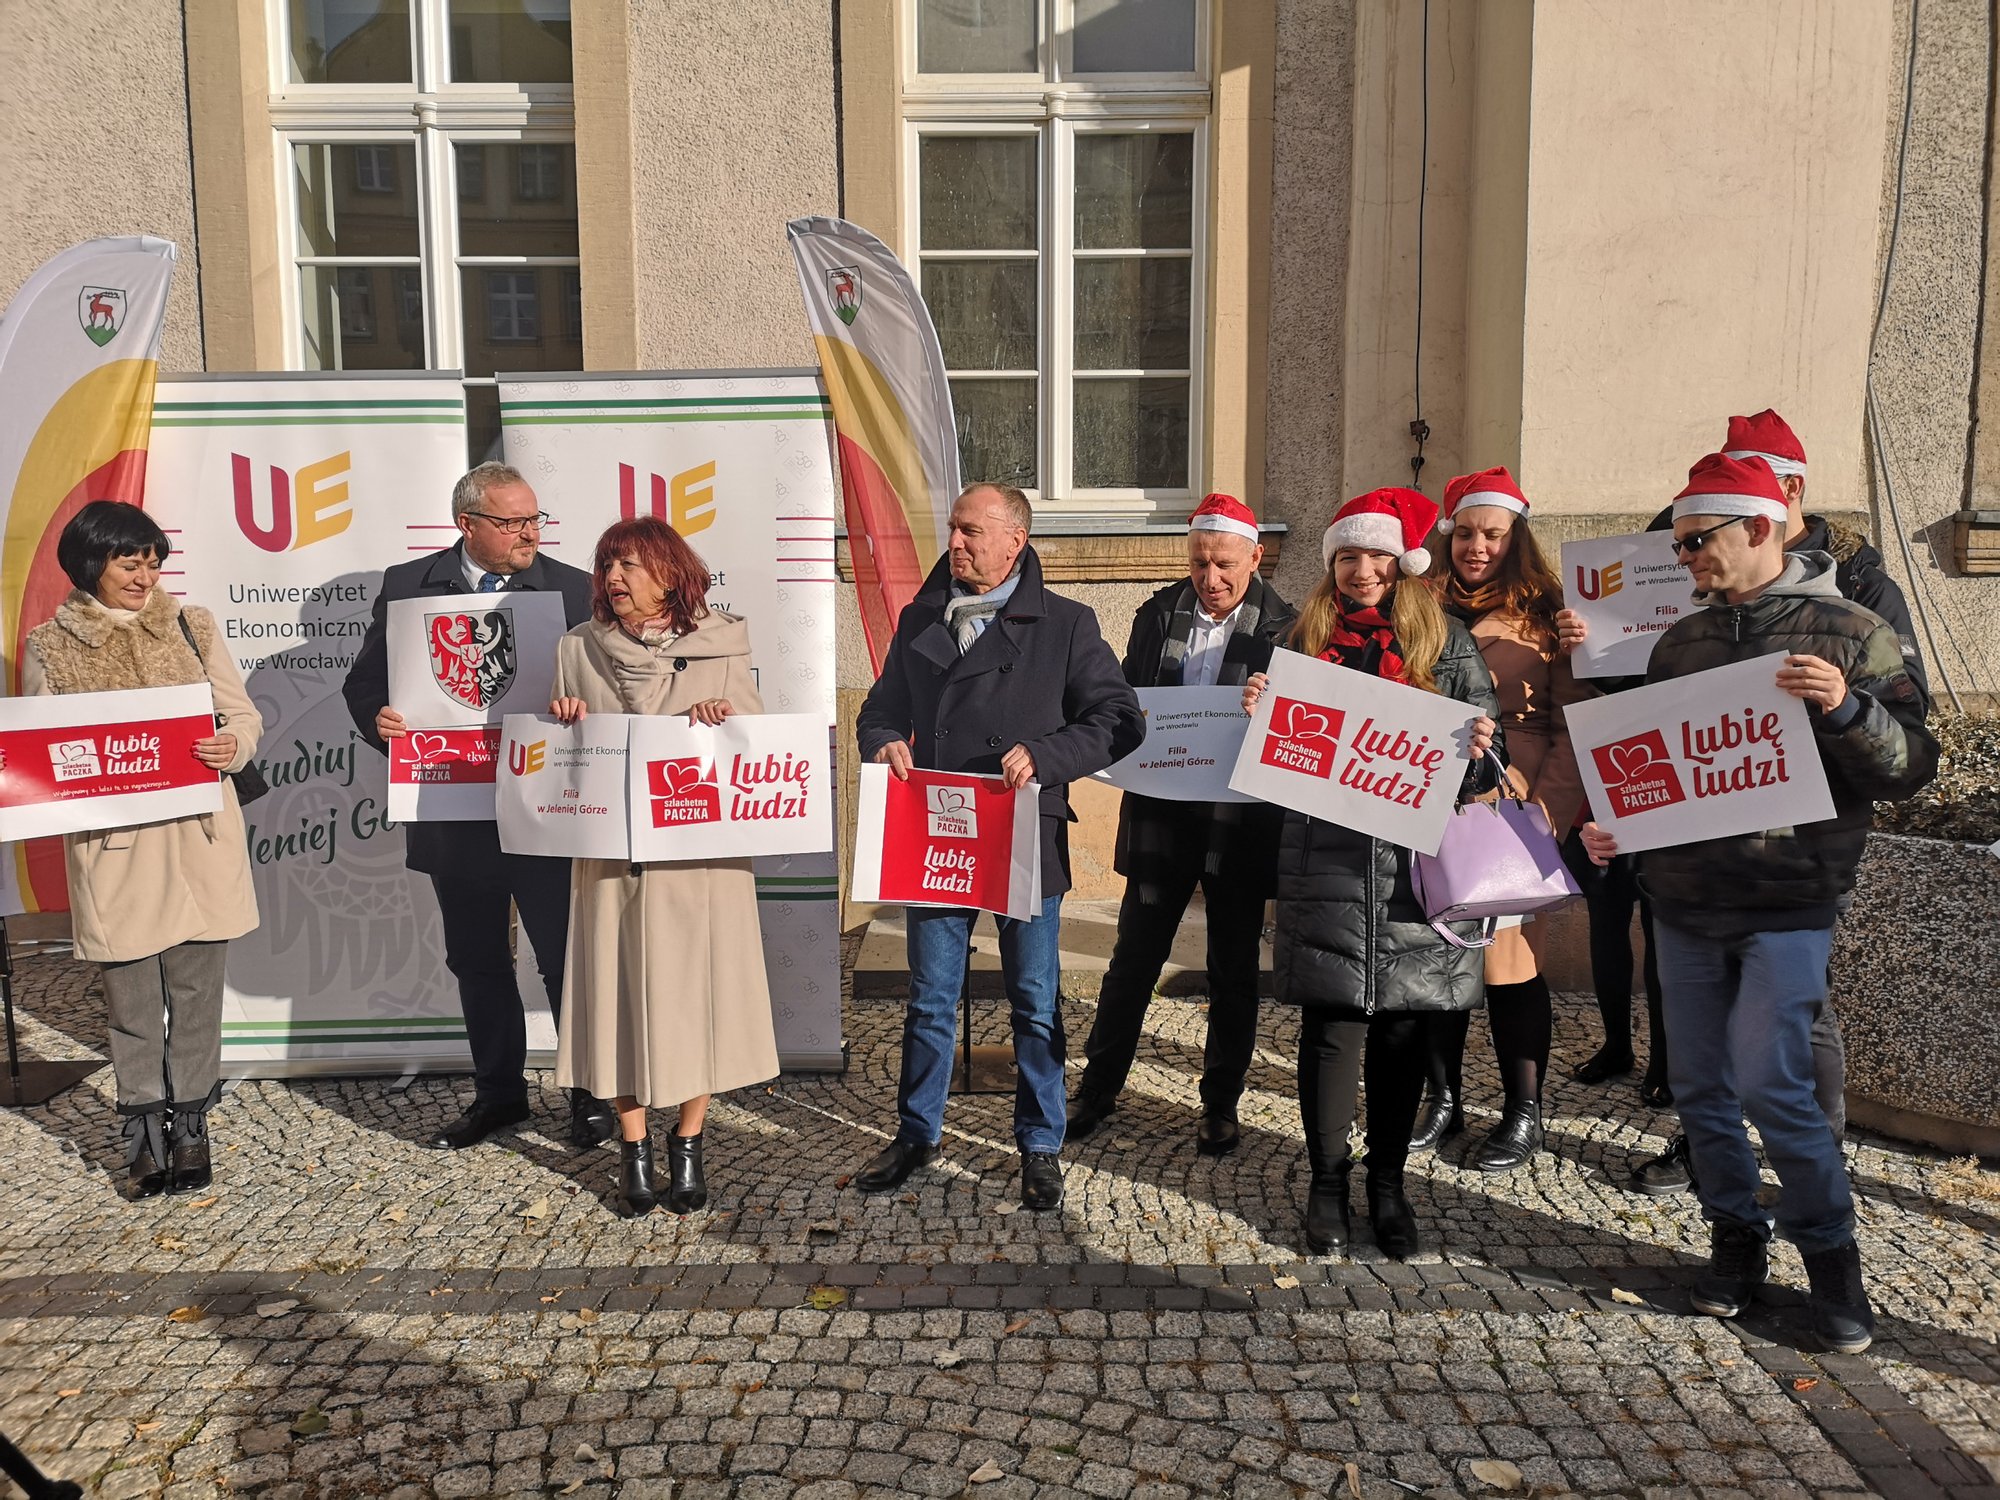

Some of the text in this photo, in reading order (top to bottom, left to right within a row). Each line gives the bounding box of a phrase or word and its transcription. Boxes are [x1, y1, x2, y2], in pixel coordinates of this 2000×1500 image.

[231, 450, 353, 553] UE
[1633, 562, 1687, 574] Uniwersyte
[1577, 560, 1623, 601] UE
[1648, 575, 1688, 585] Wrocławiu
[229, 583, 368, 607] Uniwersytet
[1655, 606, 1679, 616] Filia
[1622, 621, 1677, 633] w Jelenie
[239, 652, 355, 670] we Wrocławi
[1156, 710, 1251, 721] Uniwersytet Ekonomicz
[1166, 722, 1199, 730] Wrocławiu
[1681, 707, 1783, 766] Lubię
[104, 732, 161, 760] Lubię
[475, 740, 487, 751] W
[554, 746, 630, 757] Uniwersytet Ekonom
[1168, 746, 1187, 755] Filia
[1278, 739, 1323, 759] szlachetna
[1350, 718, 1444, 780] Lubię
[106, 754, 161, 775] ludzi
[257, 730, 356, 788] tudiuj
[467, 751, 491, 762] tkwi
[509, 739, 546, 776] UE
[1149, 759, 1185, 769] Jeleniej
[1187, 757, 1215, 767] Górze
[1273, 748, 1319, 773] PACZKA
[62, 768, 93, 777] PACZKA
[411, 762, 451, 770] szlachetna
[730, 752, 811, 794] Lubię
[1693, 748, 1790, 799] ludzi
[411, 771, 451, 781] PACZKA
[1339, 757, 1431, 809] ludzi
[563, 789, 579, 799] Filia
[1620, 778, 1667, 795] szlachetna
[664, 797, 708, 807] szlachetna
[730, 790, 808, 822] ludzi
[1622, 789, 1671, 809] PACZKA
[537, 804, 608, 816] w Jeleniej Górze
[664, 807, 709, 821] PACZKA
[937, 815, 968, 825] szlachetna
[937, 822, 968, 835] PACZKA
[247, 808, 337, 869] leniej
[923, 845, 976, 876] Lubię
[922, 870, 974, 894] ludzi
